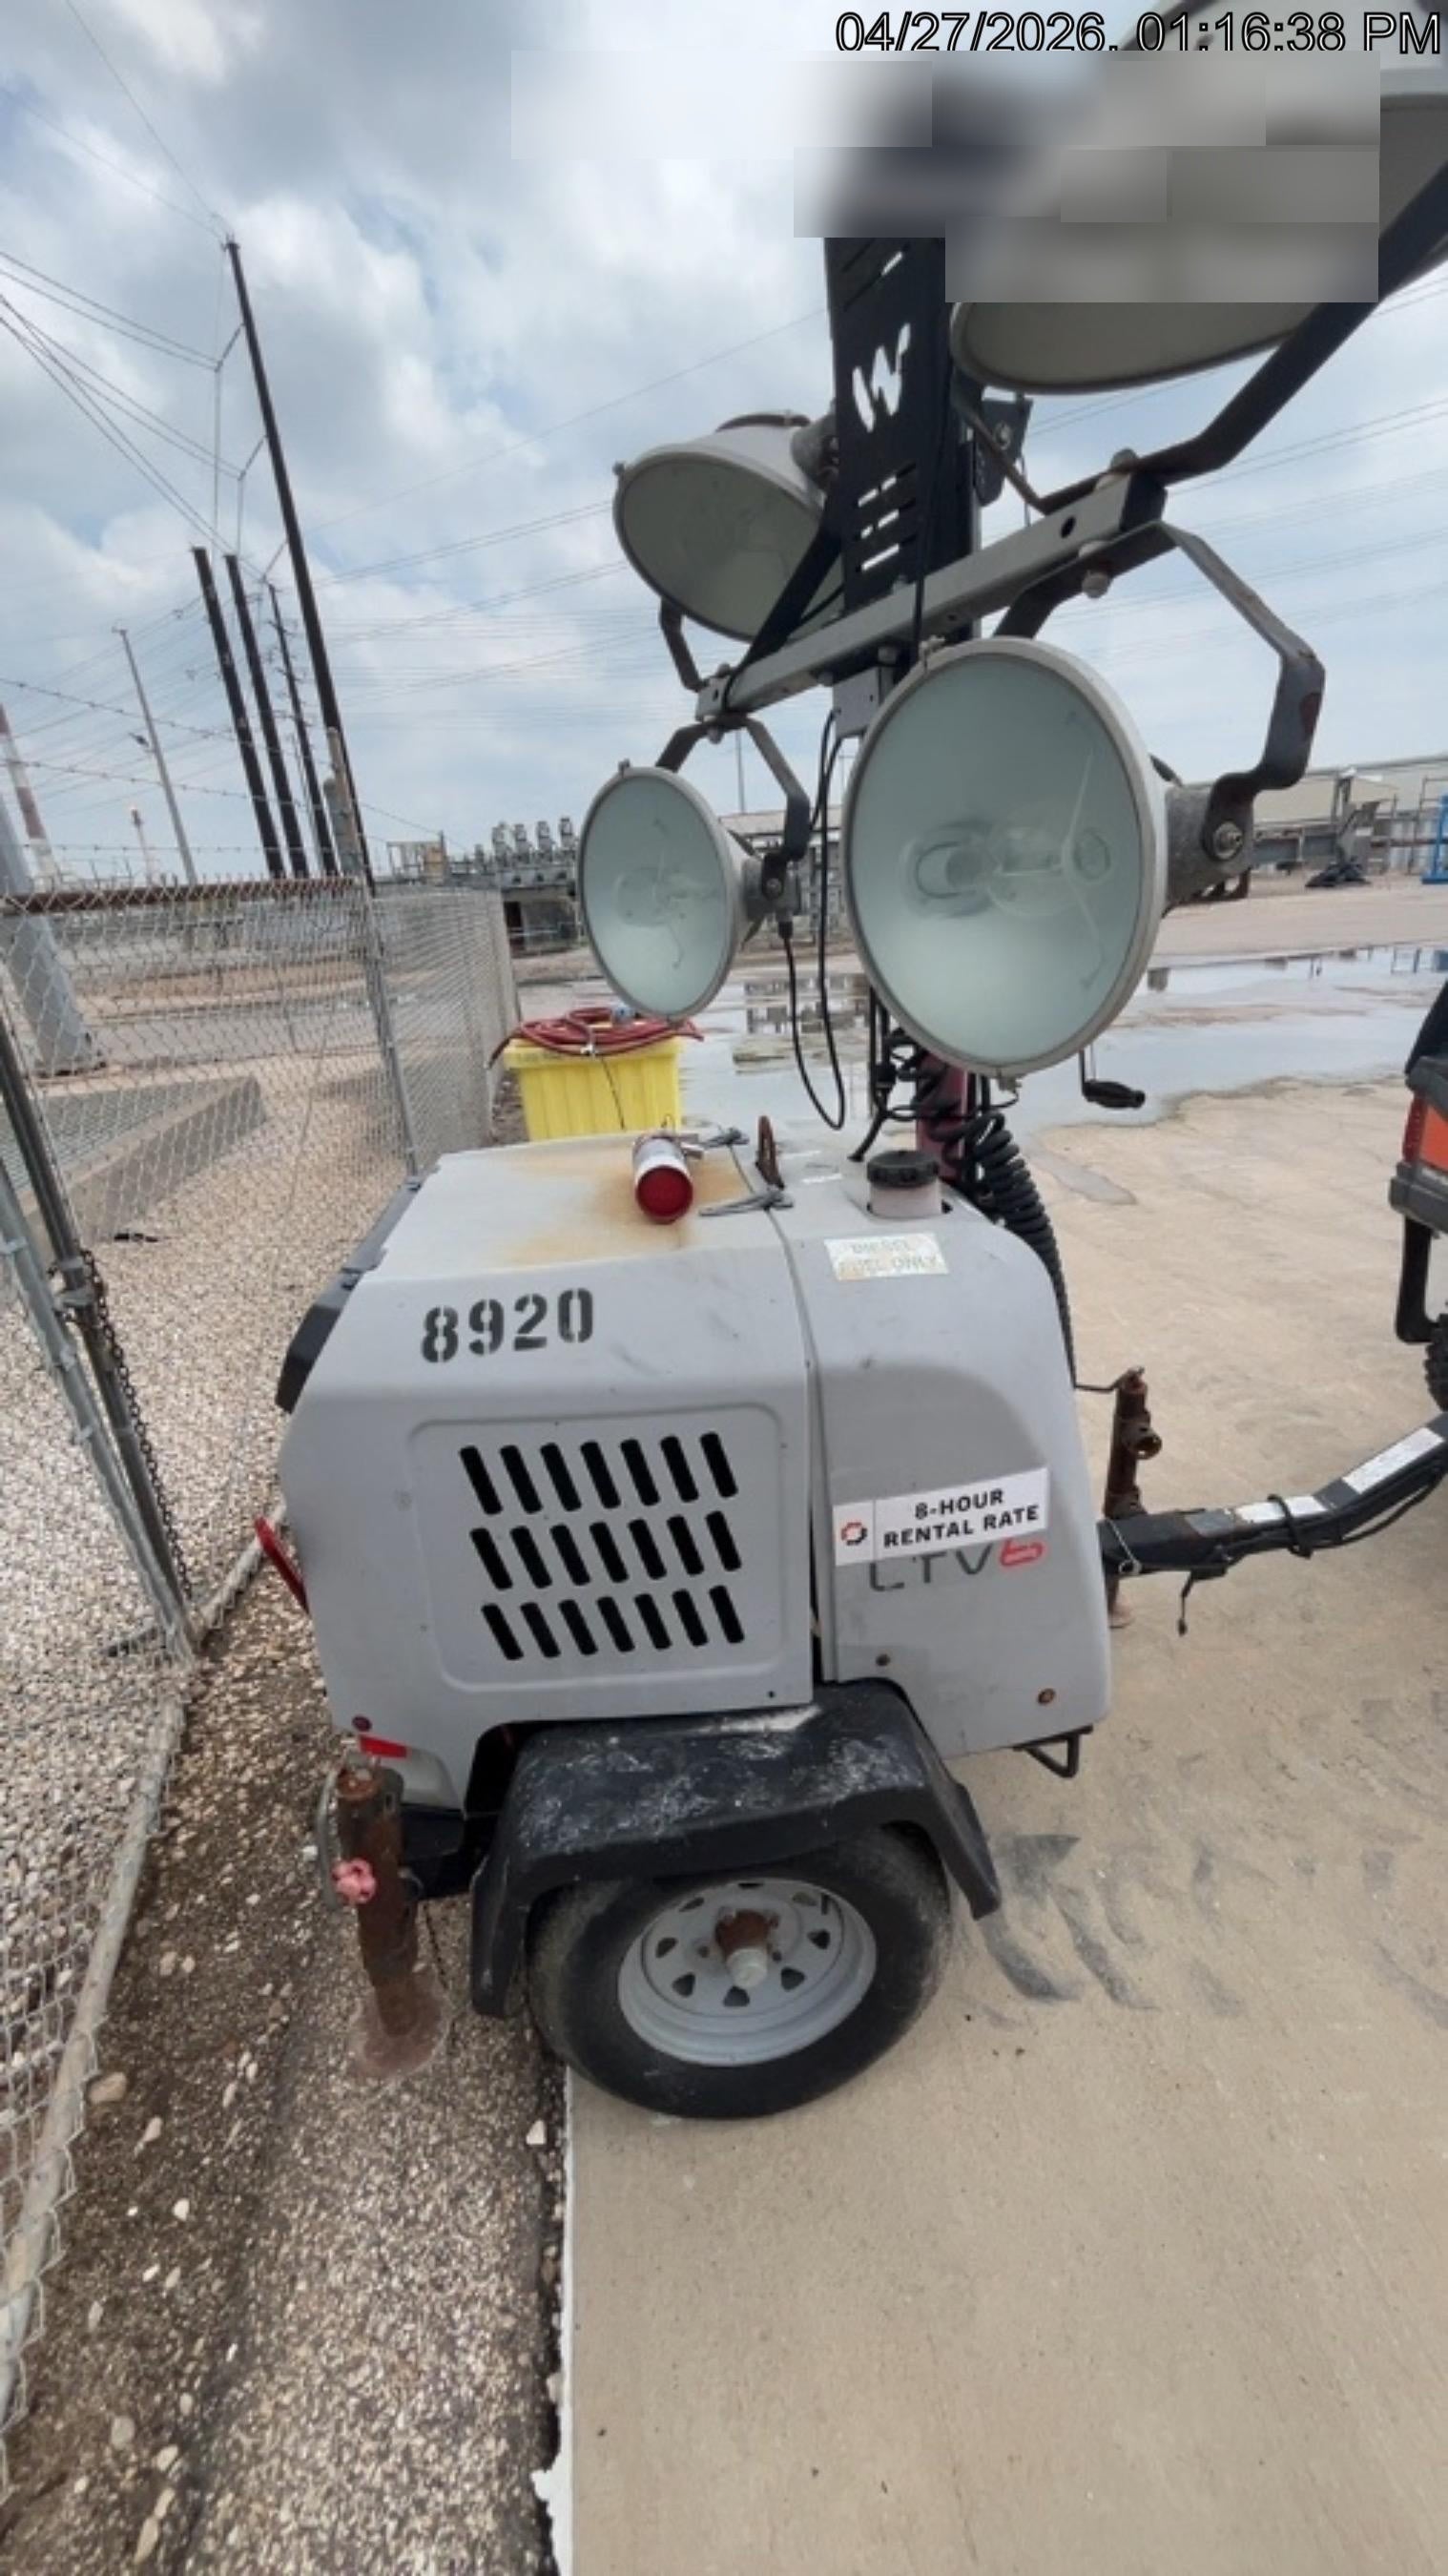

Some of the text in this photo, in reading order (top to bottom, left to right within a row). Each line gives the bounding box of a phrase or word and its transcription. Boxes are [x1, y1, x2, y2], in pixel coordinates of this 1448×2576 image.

[421, 1287, 593, 1363] 8920
[914, 1487, 1004, 1520] 8-HOUR
[883, 1505, 1040, 1548] RENTAL RATE
